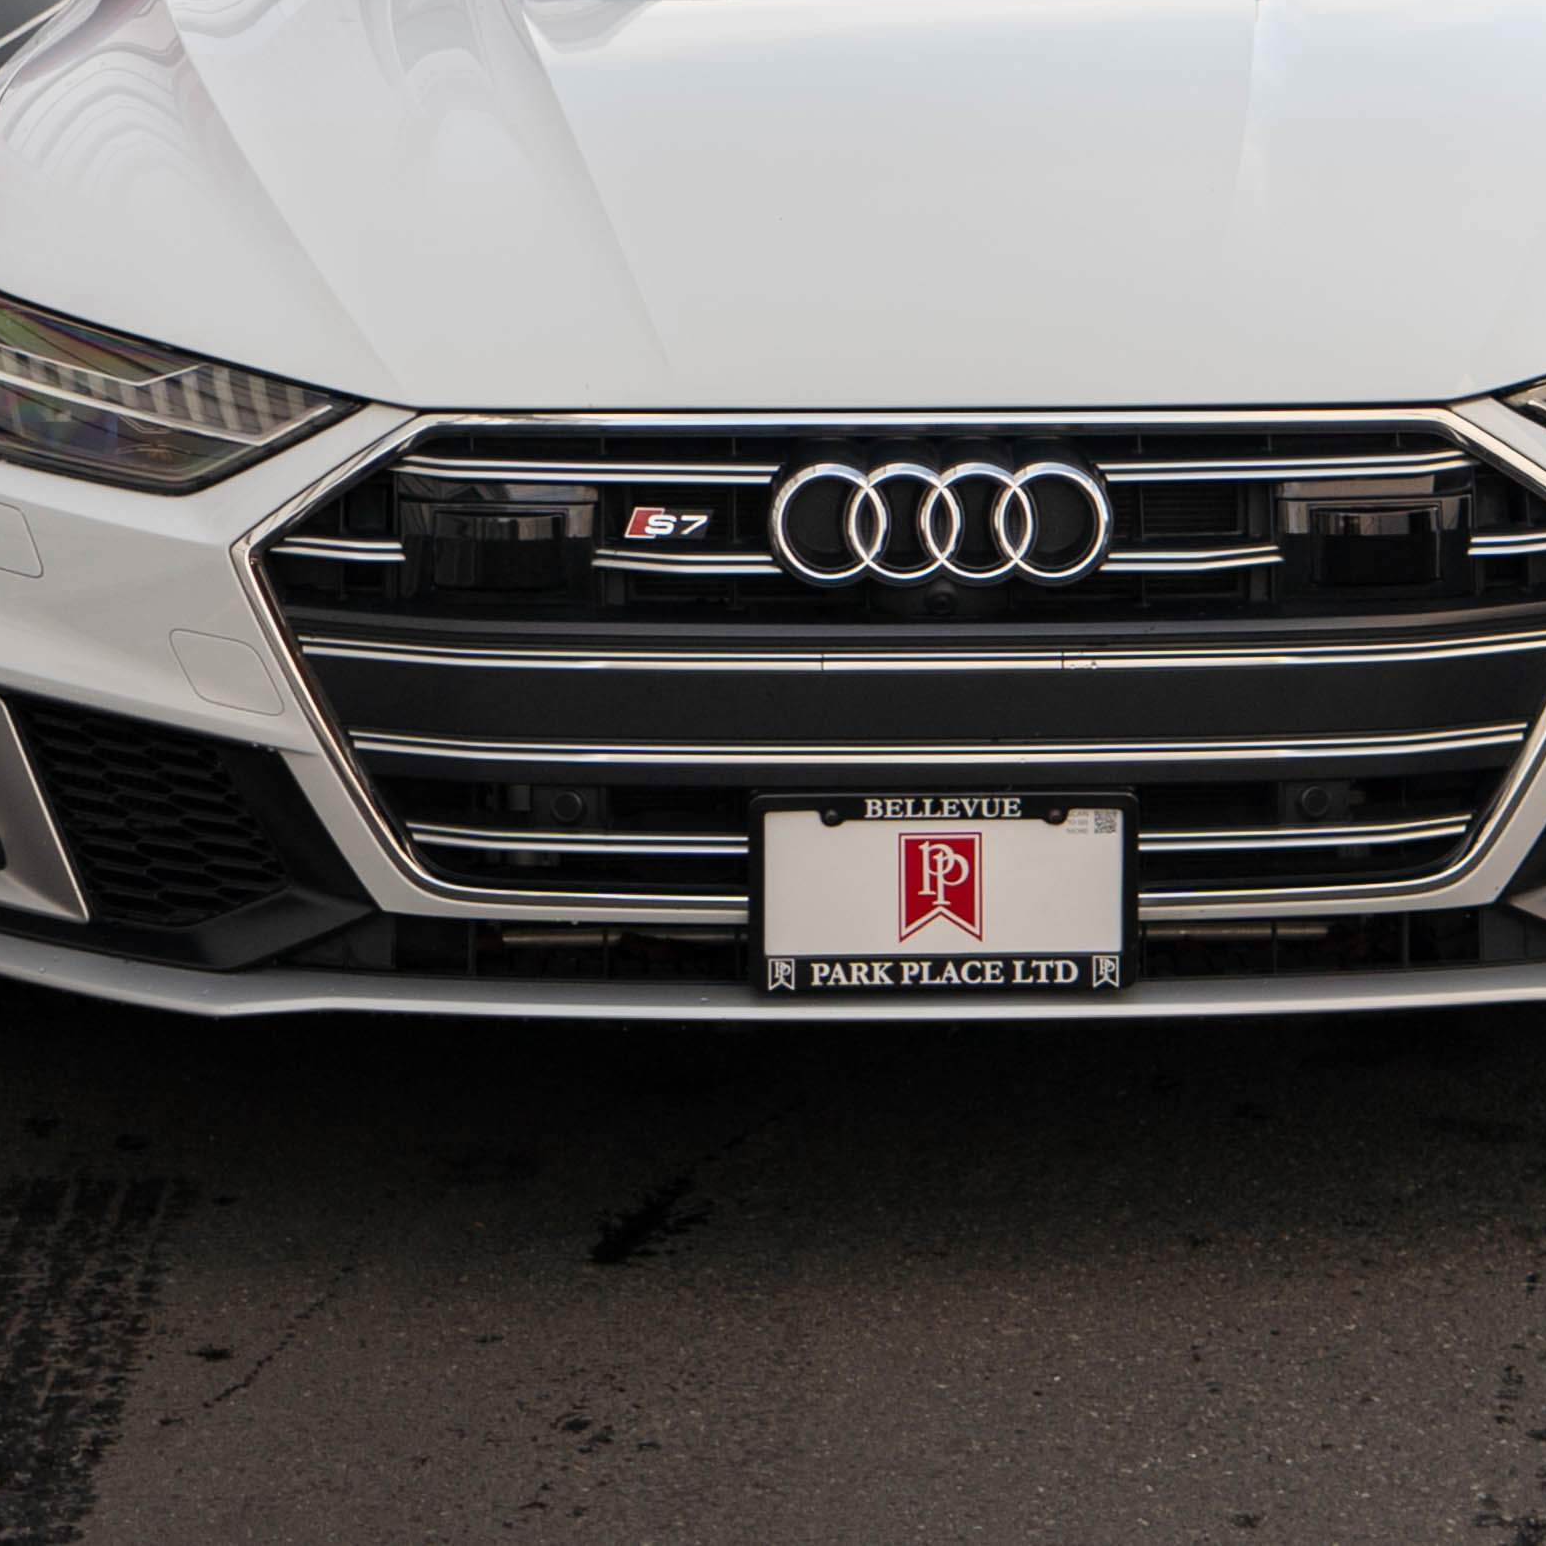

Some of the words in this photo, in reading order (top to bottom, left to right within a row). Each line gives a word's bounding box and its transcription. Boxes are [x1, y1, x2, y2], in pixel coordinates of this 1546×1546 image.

[644, 514, 709, 536] S7
[864, 797, 1023, 819] BELLEVUE
[810, 961, 895, 986] PARK
[900, 960, 1005, 985] PLACE
[1011, 959, 1080, 984] LTD
